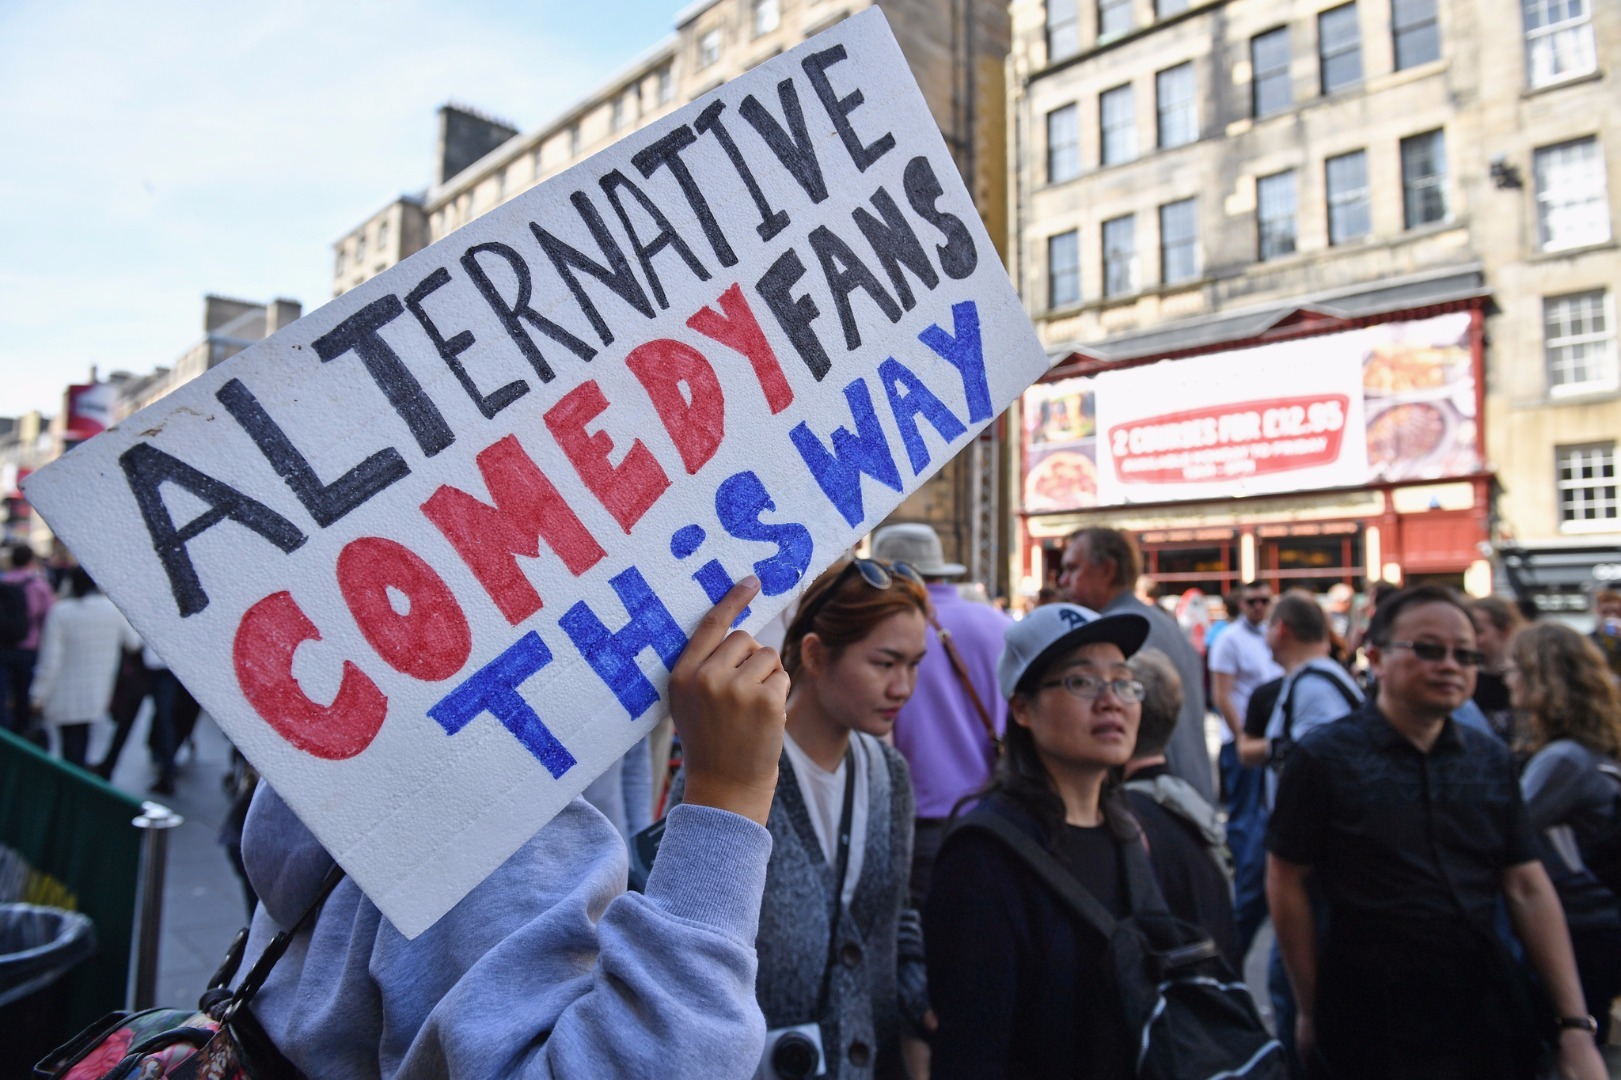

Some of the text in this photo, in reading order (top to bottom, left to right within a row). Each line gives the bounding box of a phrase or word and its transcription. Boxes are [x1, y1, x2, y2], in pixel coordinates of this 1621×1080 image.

[119, 43, 896, 617] ALTERNATIVE
[233, 156, 978, 760] COMEDY FANS
[789, 300, 993, 529] WAY
[1112, 429, 1129, 456] 2
